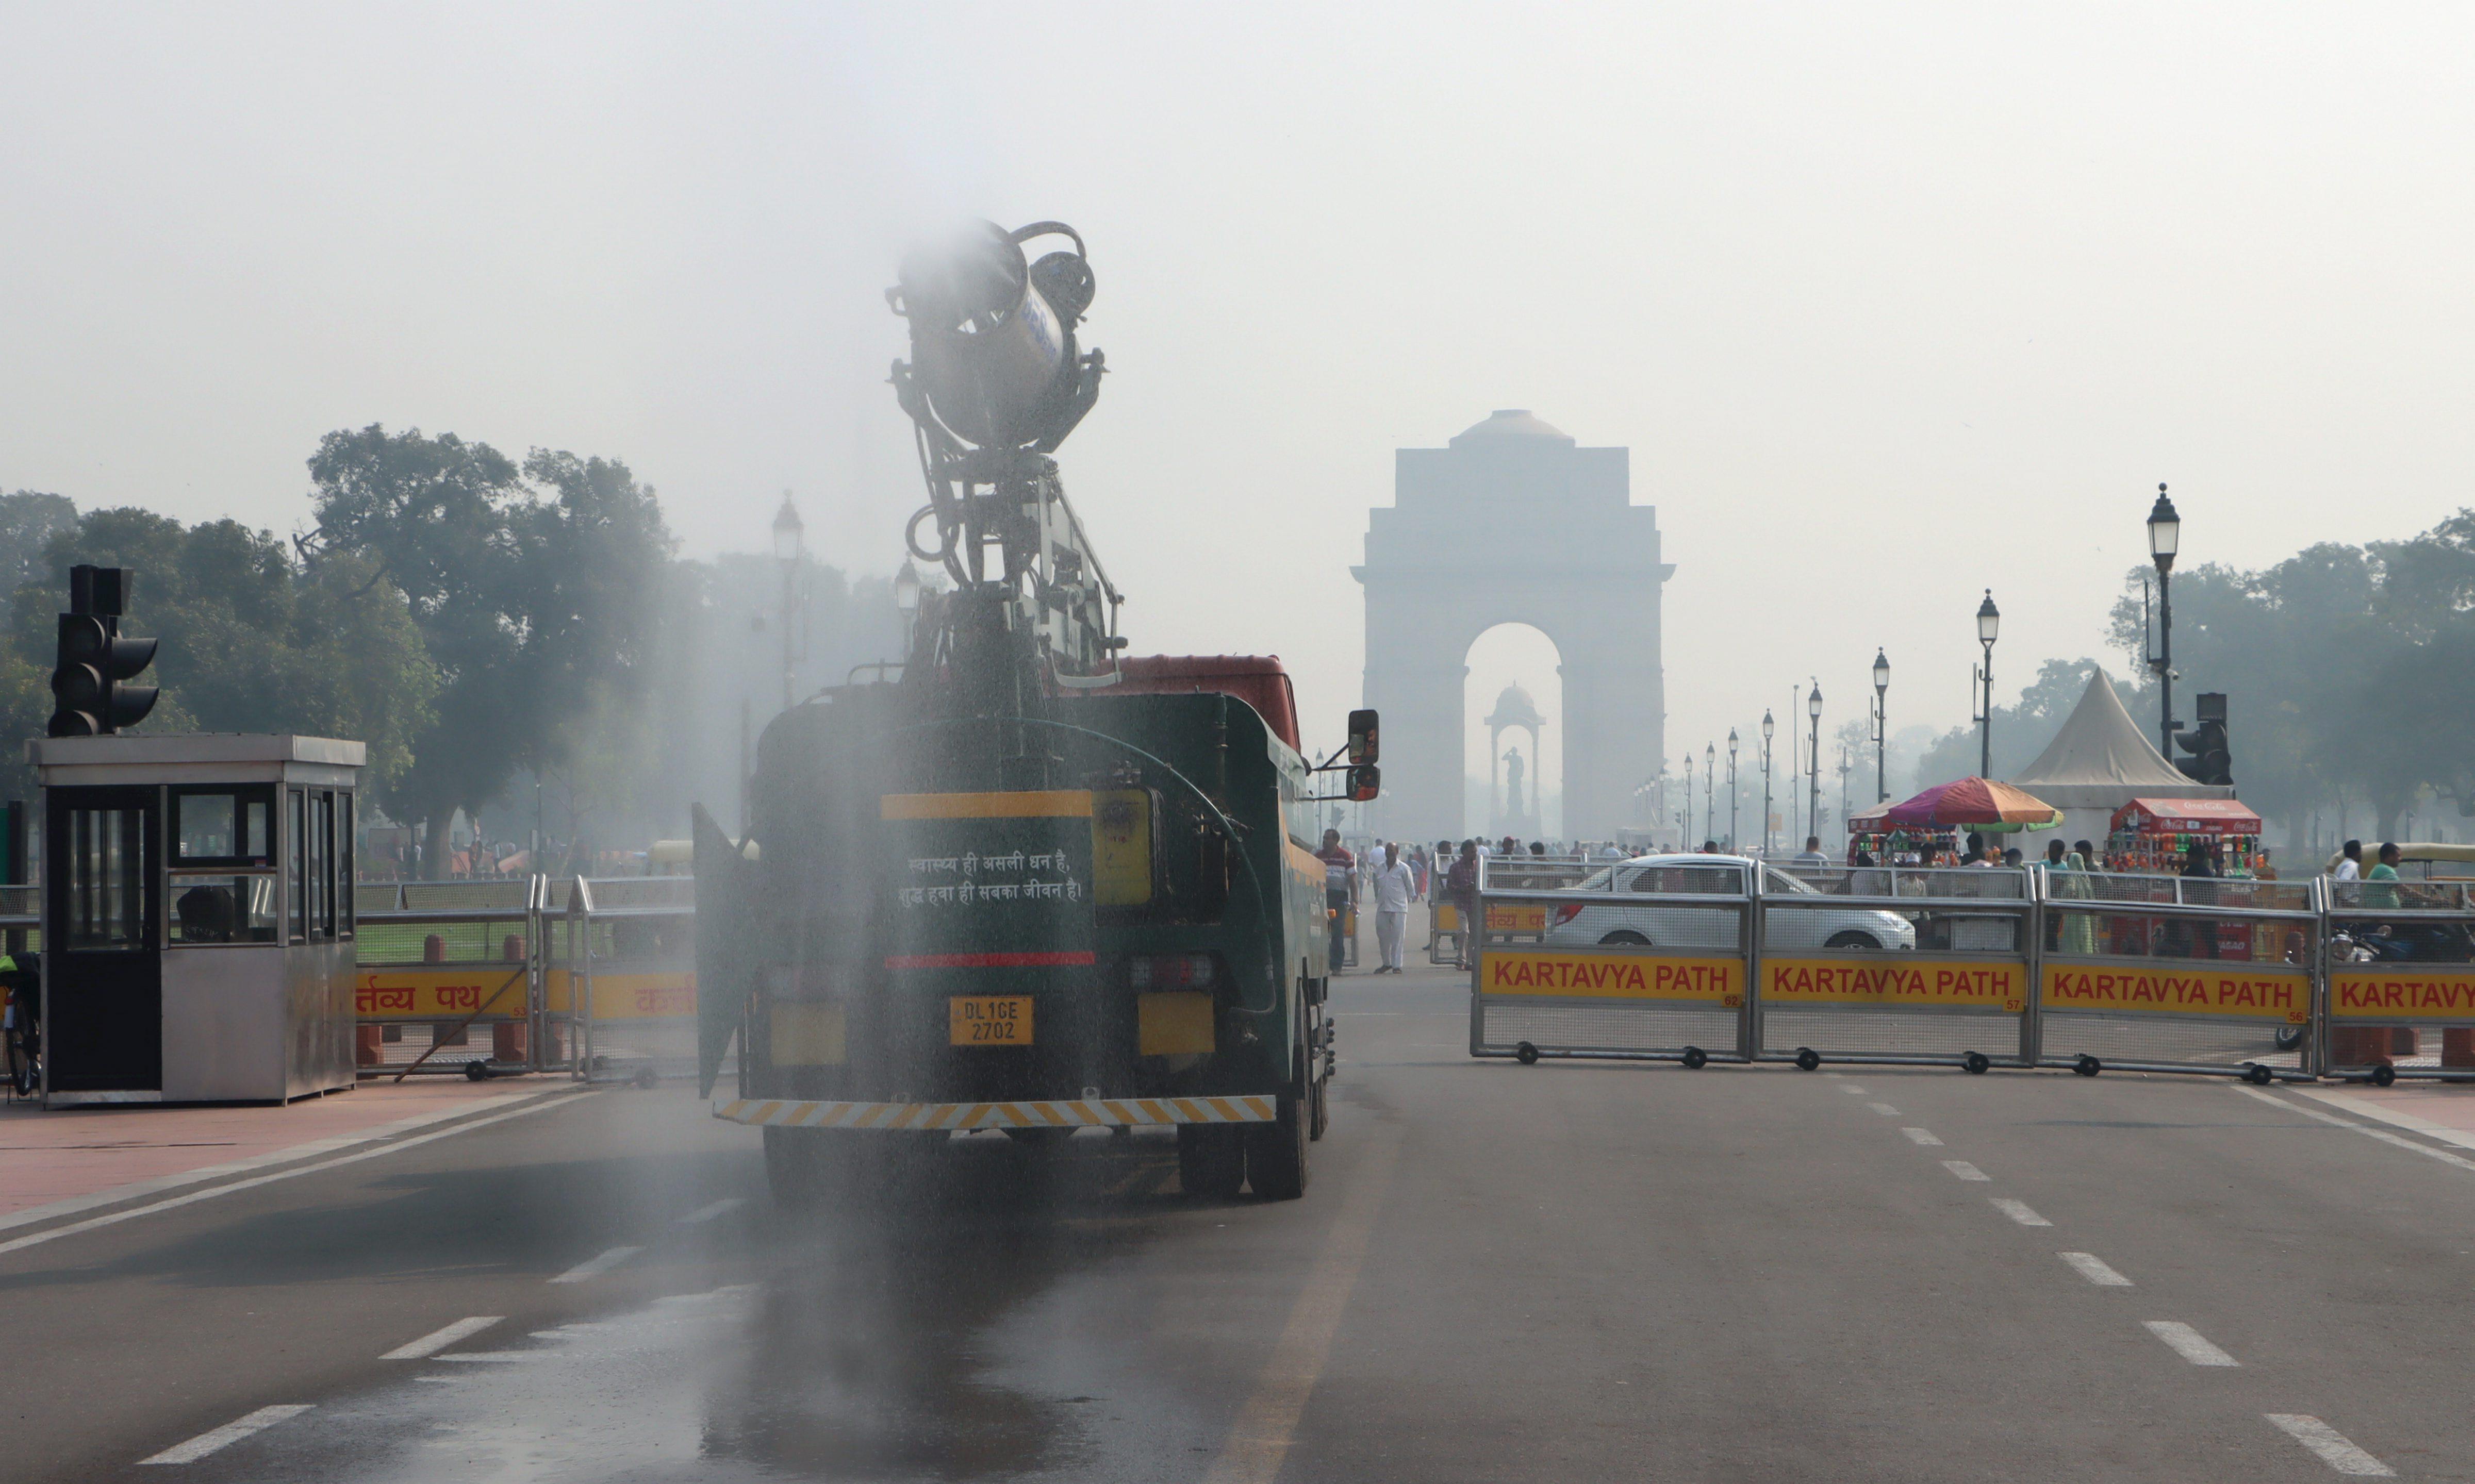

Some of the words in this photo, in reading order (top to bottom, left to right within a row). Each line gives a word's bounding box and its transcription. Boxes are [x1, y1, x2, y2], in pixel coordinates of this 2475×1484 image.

[908, 857, 958, 873] स्वास्थ्य
[962, 852, 979, 876] ही
[983, 850, 1025, 871] असली
[1029, 855, 1051, 870] धन
[1055, 848, 1070, 874] है,
[928, 887, 955, 906] हवा
[958, 880, 975, 906] ही
[978, 884, 1019, 901] सबका
[1022, 878, 1063, 899] जीवन
[1495, 961, 1646, 989] KARTAVYA
[1656, 965, 1727, 992] PATH
[1774, 967, 1927, 995] KARTAVYA
[1937, 970, 2009, 996] PATH
[355, 975, 416, 1012] र्तव्य
[435, 986, 481, 1010] पथ
[1724, 995, 1738, 1006] 62
[2054, 973, 2209, 1005] KARTAVYA
[2219, 980, 2292, 1008] PATH
[2341, 982, 2475, 1008] KARTAVY
[514, 1006, 528, 1016] 53
[2007, 999, 2021, 1010] 57
[2289, 1011, 2303, 1022] 56
[972, 1021, 1015, 1041] 2702
